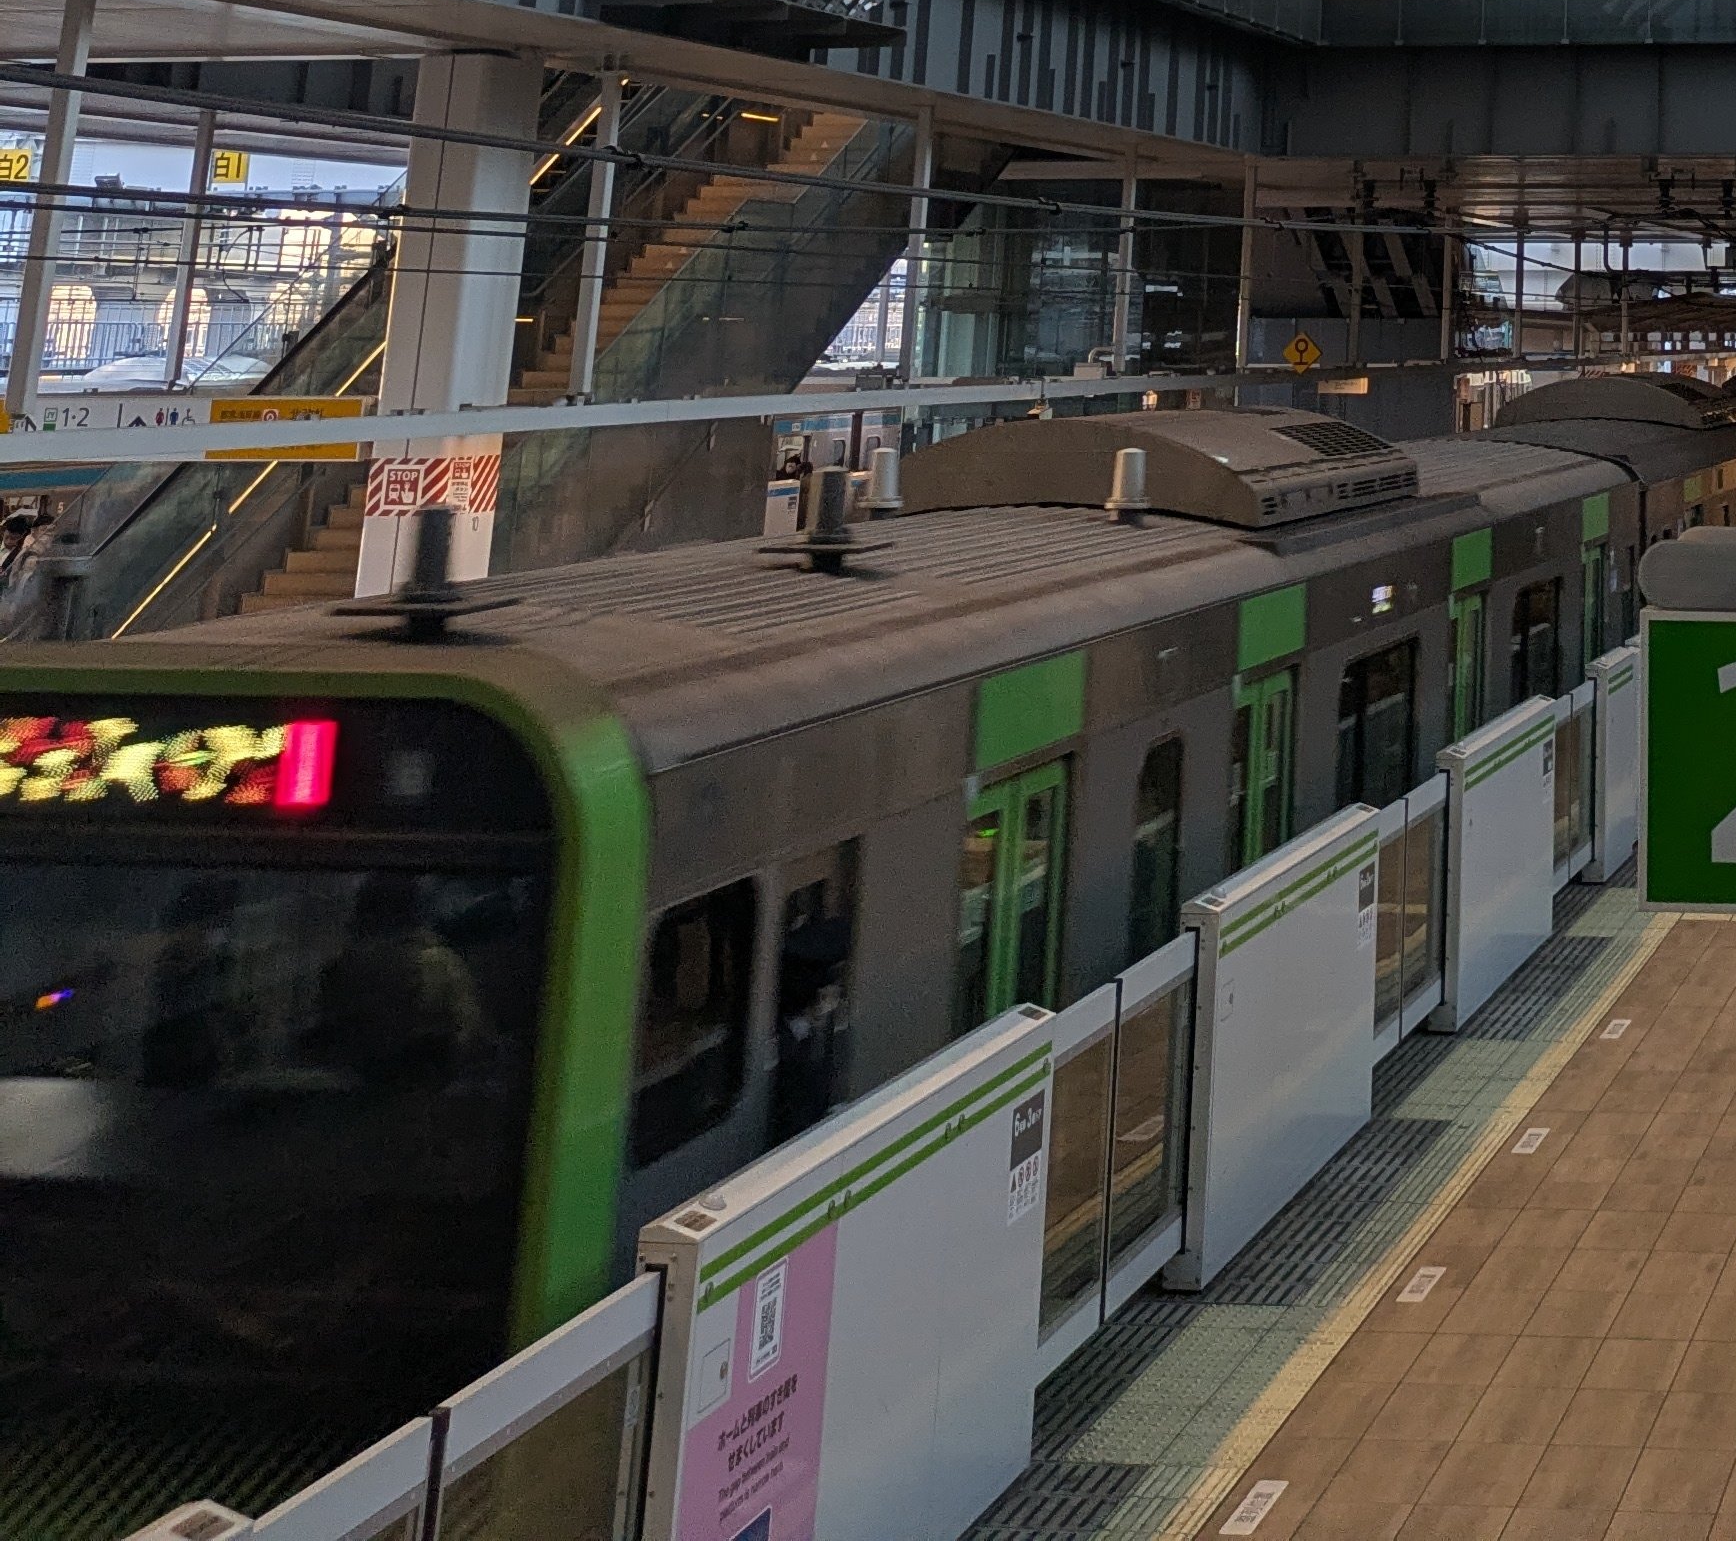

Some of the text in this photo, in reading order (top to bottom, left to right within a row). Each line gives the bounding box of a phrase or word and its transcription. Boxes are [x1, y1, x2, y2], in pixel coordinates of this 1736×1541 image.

[389, 470, 418, 482] STOP
[728, 1410, 785, 1473] せまくしています
